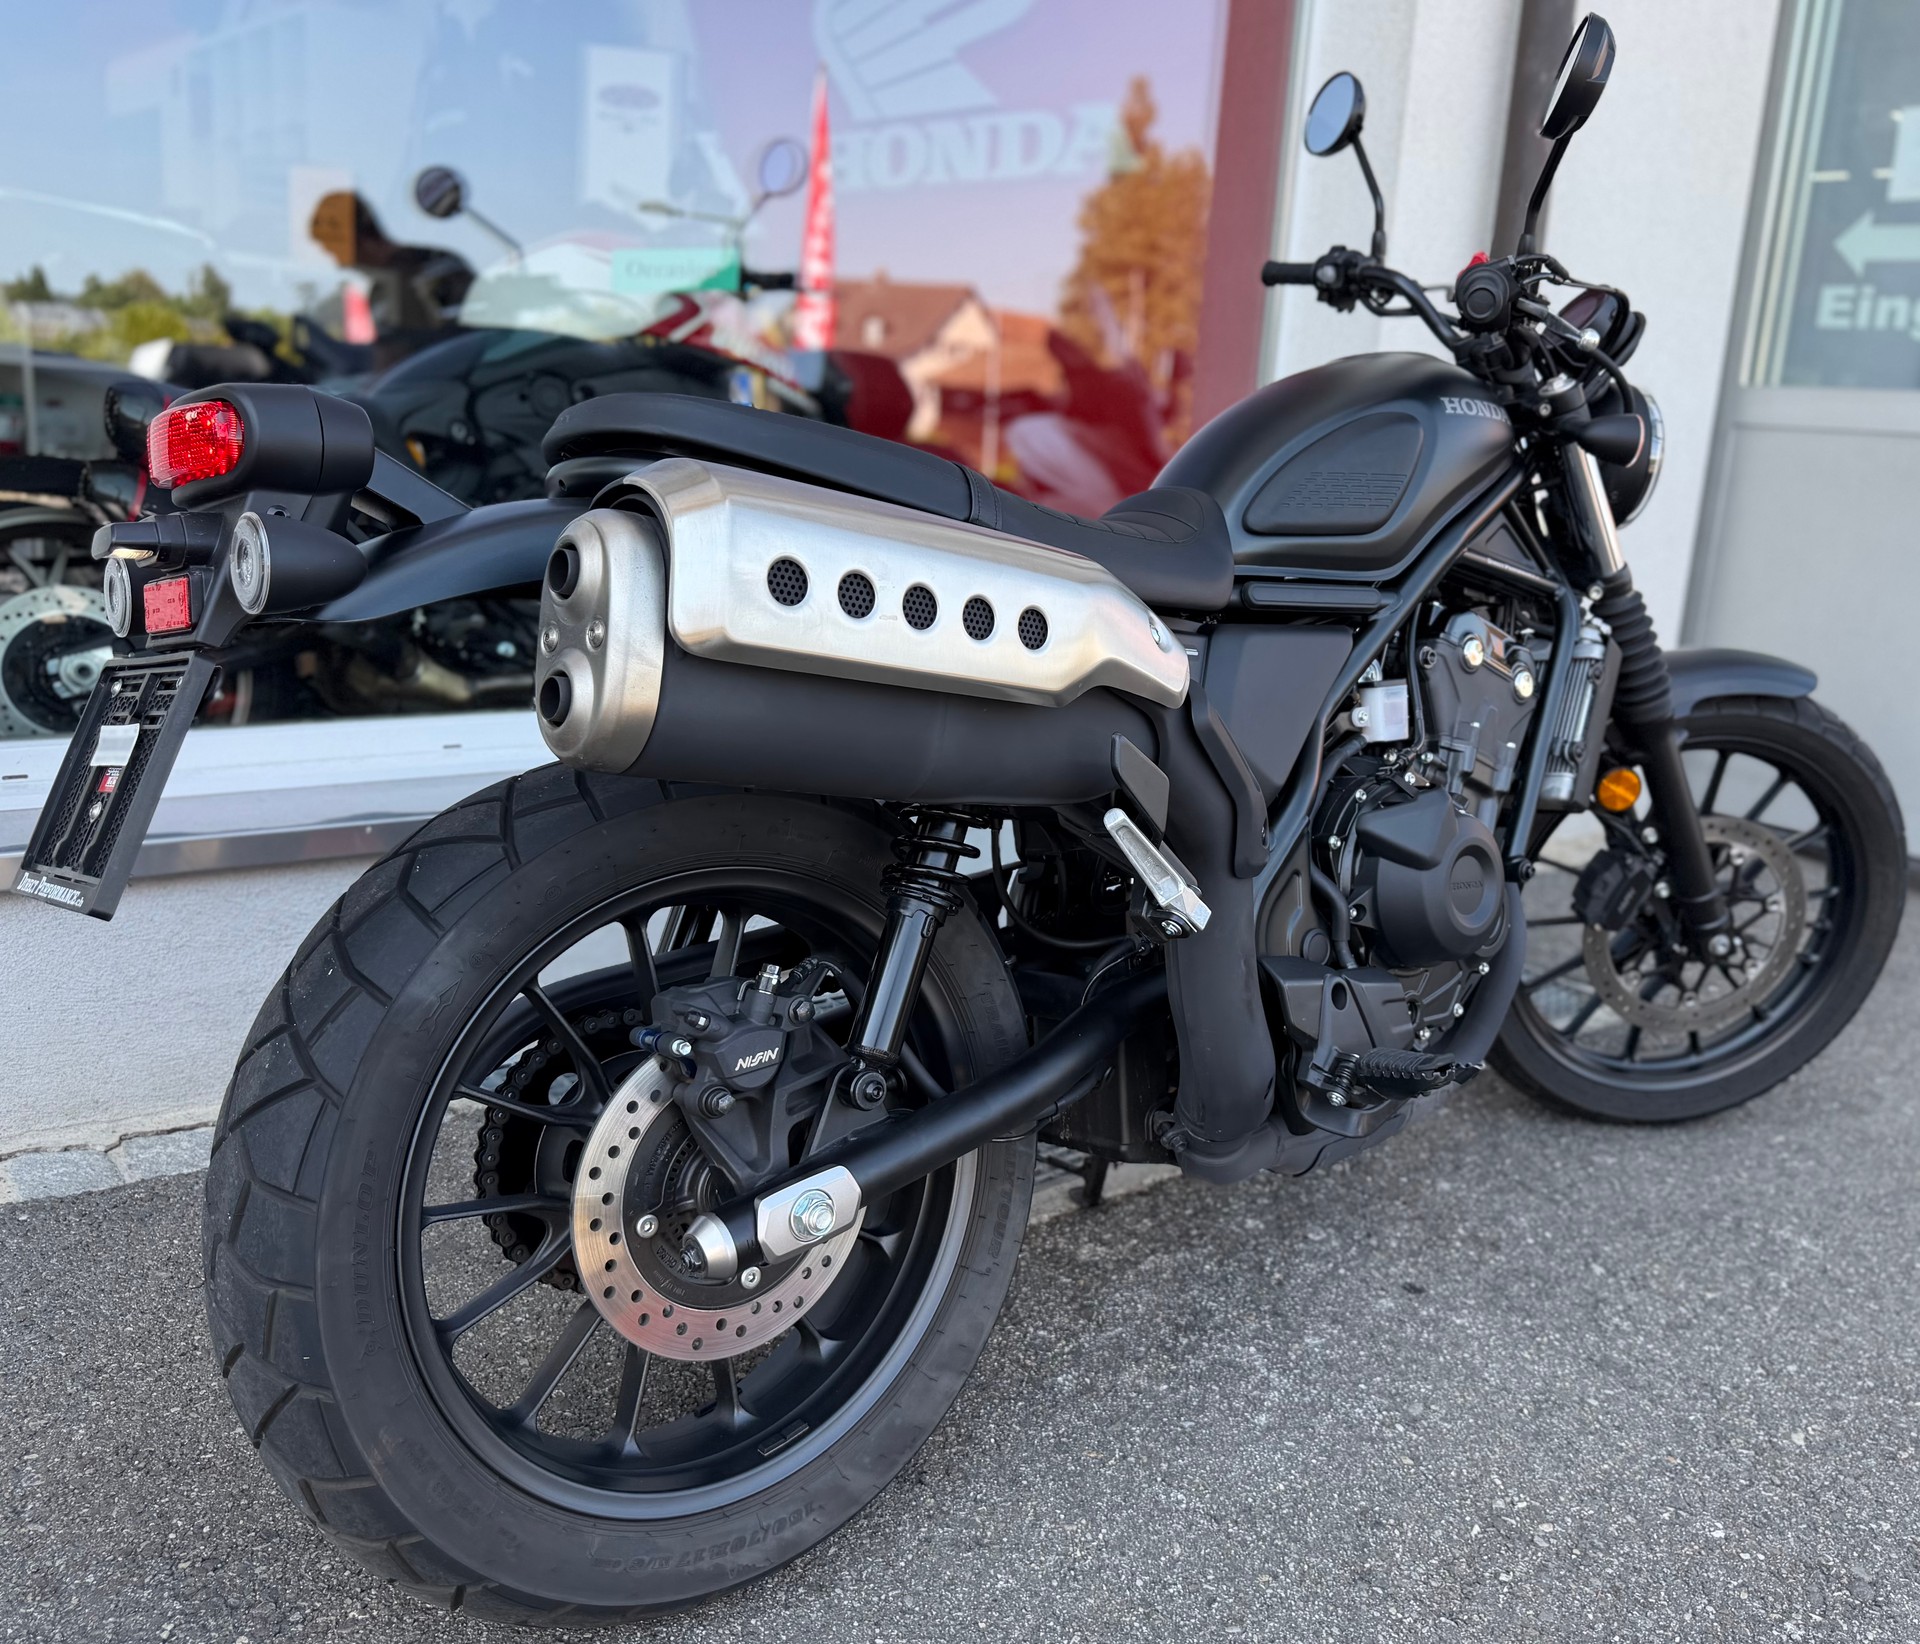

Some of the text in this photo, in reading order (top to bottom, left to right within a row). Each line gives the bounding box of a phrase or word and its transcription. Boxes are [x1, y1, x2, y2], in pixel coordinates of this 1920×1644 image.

[829, 99, 1146, 190] HONDA
[1440, 396, 1512, 426] HONDA
[734, 1046, 780, 1072] NISSIN
[351, 1149, 379, 1326] DUNLOP
